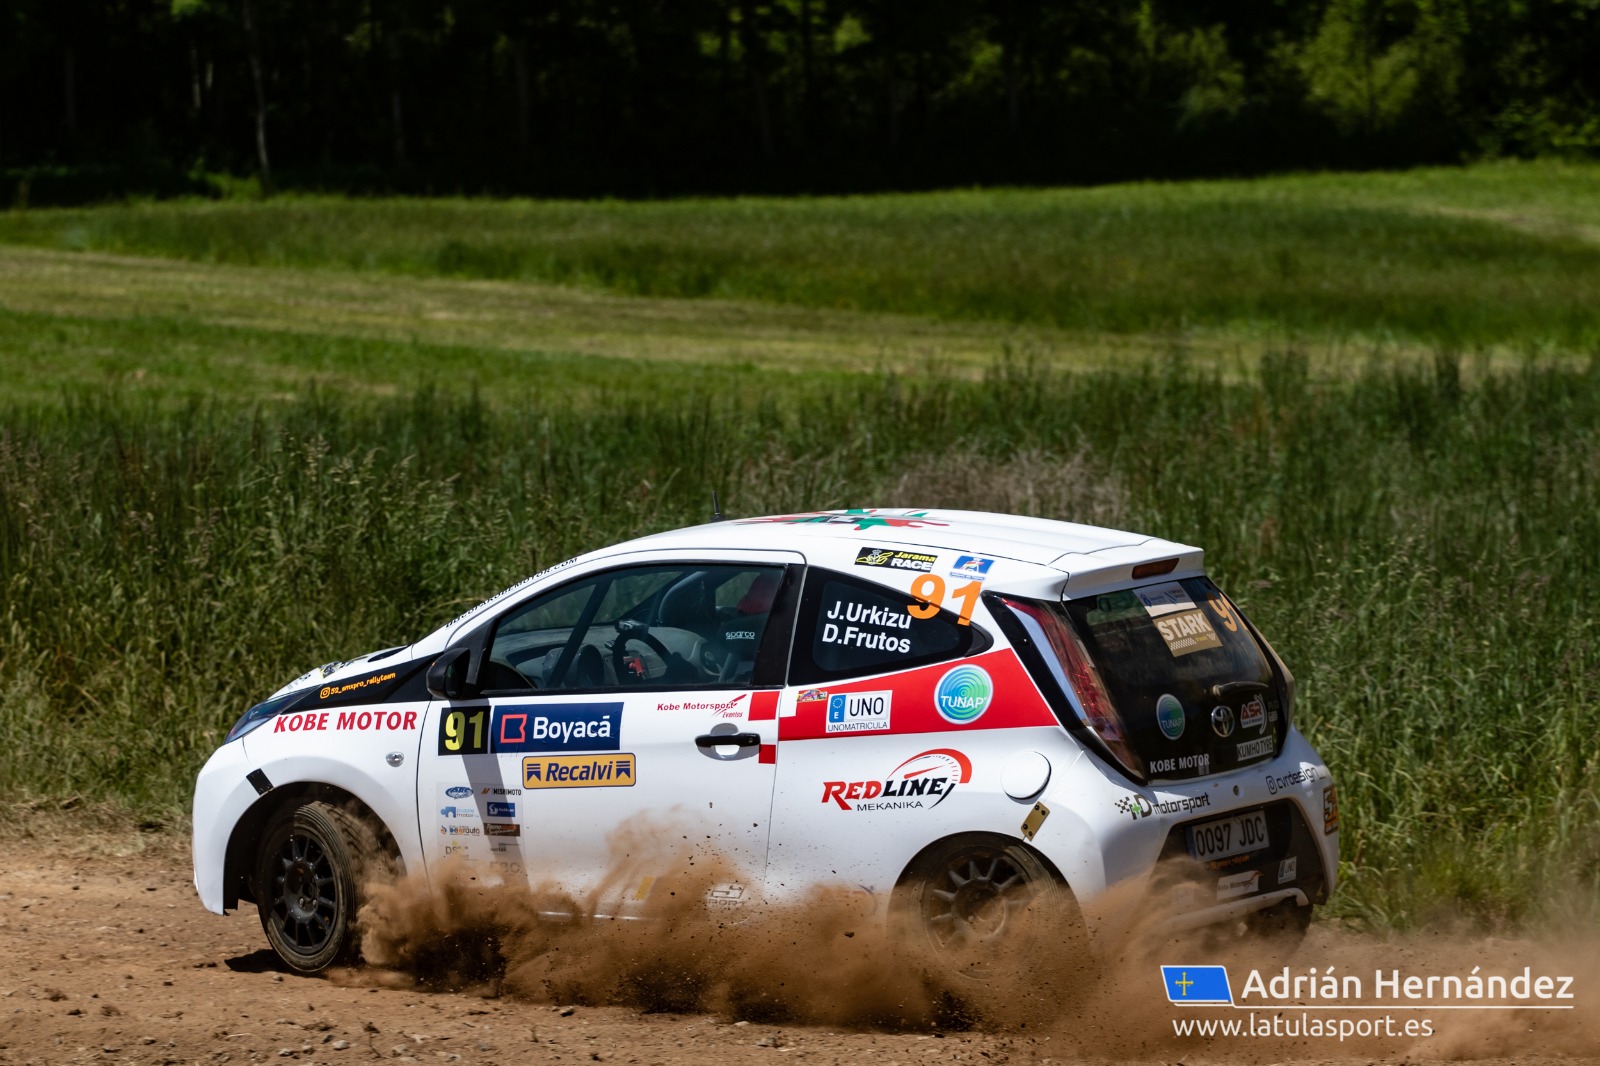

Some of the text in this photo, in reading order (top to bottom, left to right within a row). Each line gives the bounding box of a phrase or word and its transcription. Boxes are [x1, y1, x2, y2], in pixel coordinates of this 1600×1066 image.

[890, 558, 933, 571] RACE
[894, 551, 937, 562] Jarama
[907, 573, 983, 626] 91
[827, 601, 911, 629] J.Urkizu
[1157, 612, 1212, 641] STARK
[822, 624, 911, 653] D.Frutos
[657, 702, 735, 711] Kobe Motorsport
[850, 697, 884, 717] UNO
[941, 695, 984, 709] TUNAP
[273, 711, 417, 733] KOBE MOTOR
[833, 711, 839, 719] E
[1161, 717, 1182, 729] TUNAP
[444, 710, 485, 751] 91
[533, 715, 611, 743] Boyacá
[827, 721, 888, 732] UNOMATRICULA
[1238, 737, 1273, 758] KUMHO TYRE
[546, 761, 613, 782] Recalvi
[1150, 753, 1210, 774] KOBE MOTOR
[821, 777, 949, 811] REDLINE
[1153, 791, 1211, 814] motorsport
[856, 801, 924, 812] MEKANIKA
[1195, 817, 1265, 856] 0097 JDC
